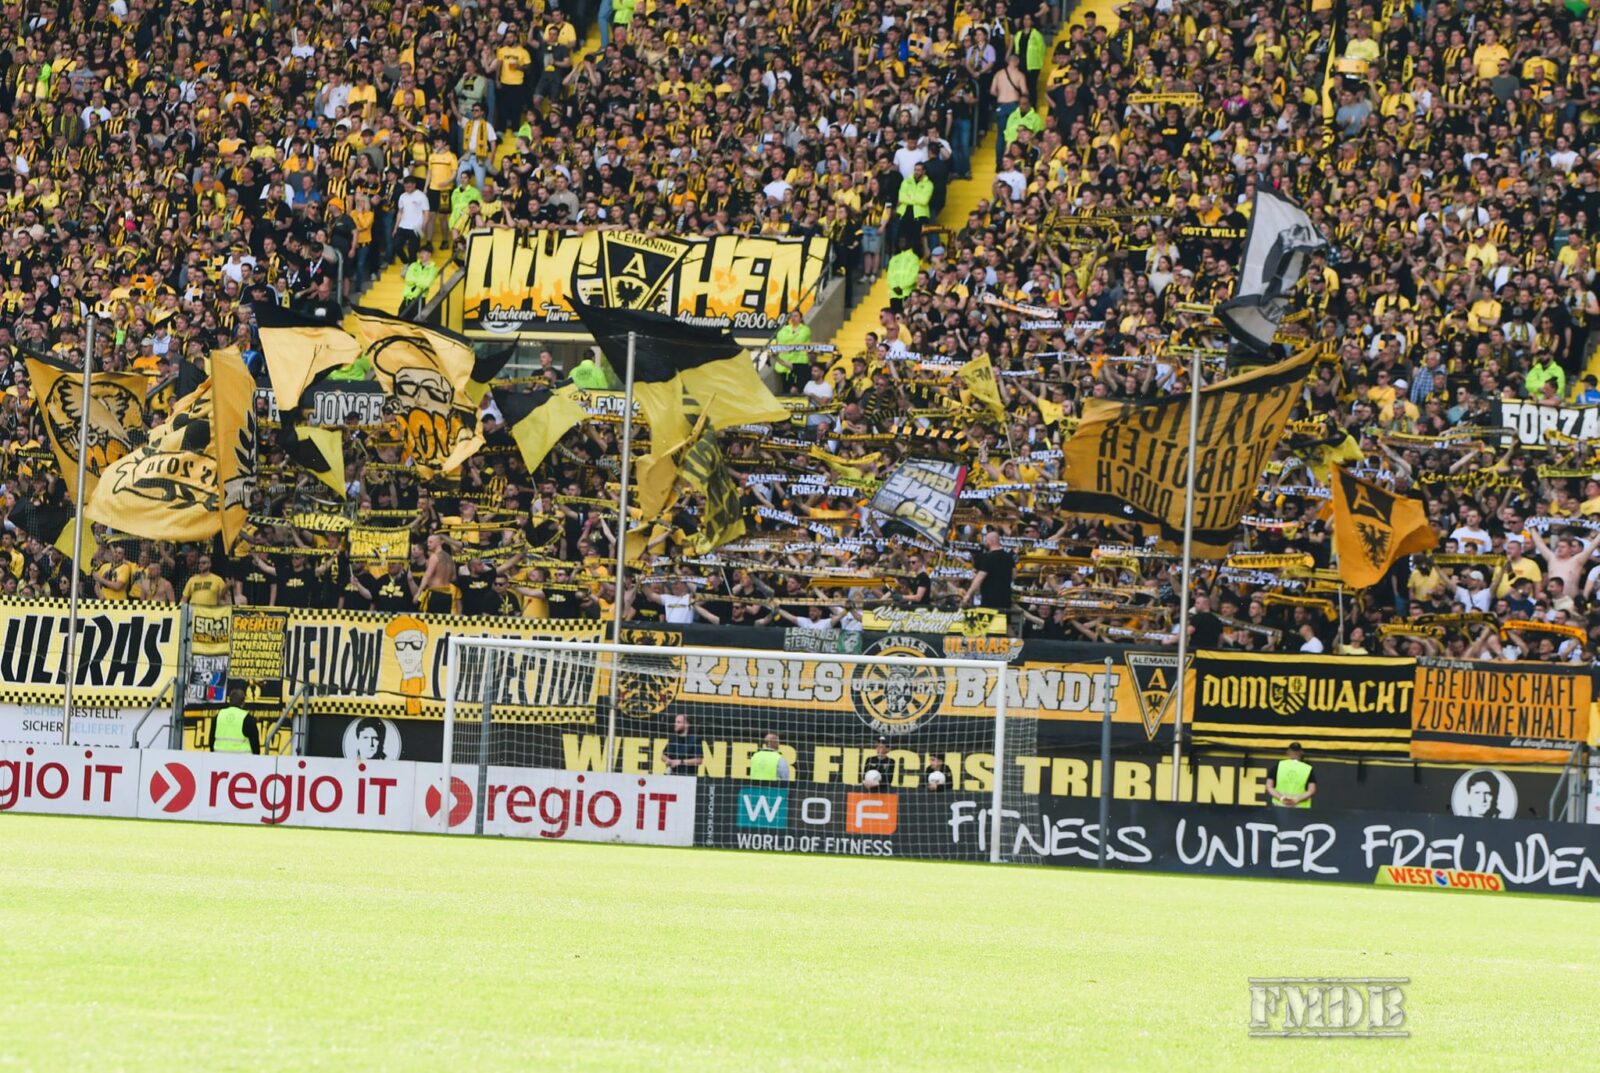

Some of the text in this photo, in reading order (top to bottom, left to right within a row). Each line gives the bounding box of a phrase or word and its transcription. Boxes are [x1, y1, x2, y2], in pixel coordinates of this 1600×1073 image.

[607, 230, 679, 256] ALEMANNIA
[1210, 227, 1237, 238] WILL
[622, 252, 647, 279] A
[488, 304, 536, 322] Aachener
[734, 312, 766, 329] 1900
[309, 393, 384, 426] JONGE
[1500, 403, 1598, 446] FORZA
[233, 615, 285, 631] FREIHEIT
[1, 614, 172, 688] ULTRAS
[879, 636, 928, 653] KARLS
[944, 636, 1010, 655] ULTRAS
[285, 625, 383, 696] YELLOW
[1133, 656, 1181, 665] ALEMANN
[682, 654, 845, 702] KARLS
[952, 666, 1121, 714] BANDE
[1147, 667, 1168, 689] A
[1423, 667, 1577, 707] FREUNDSCHAFT
[1203, 673, 1415, 714] DOM WACHT
[22, 719, 64, 733] SICHER
[1417, 698, 1577, 739] ZUSAMMENHALT
[208, 761, 344, 824] regio
[1016, 755, 1268, 806] TRIBÜNE
[486, 774, 622, 839] regio
[737, 833, 893, 856] WORLD OF FITNESS
[948, 800, 1152, 864] FITNESS
[1176, 818, 1339, 875] UNTER
[1388, 867, 1500, 891] WEST LOTTO
